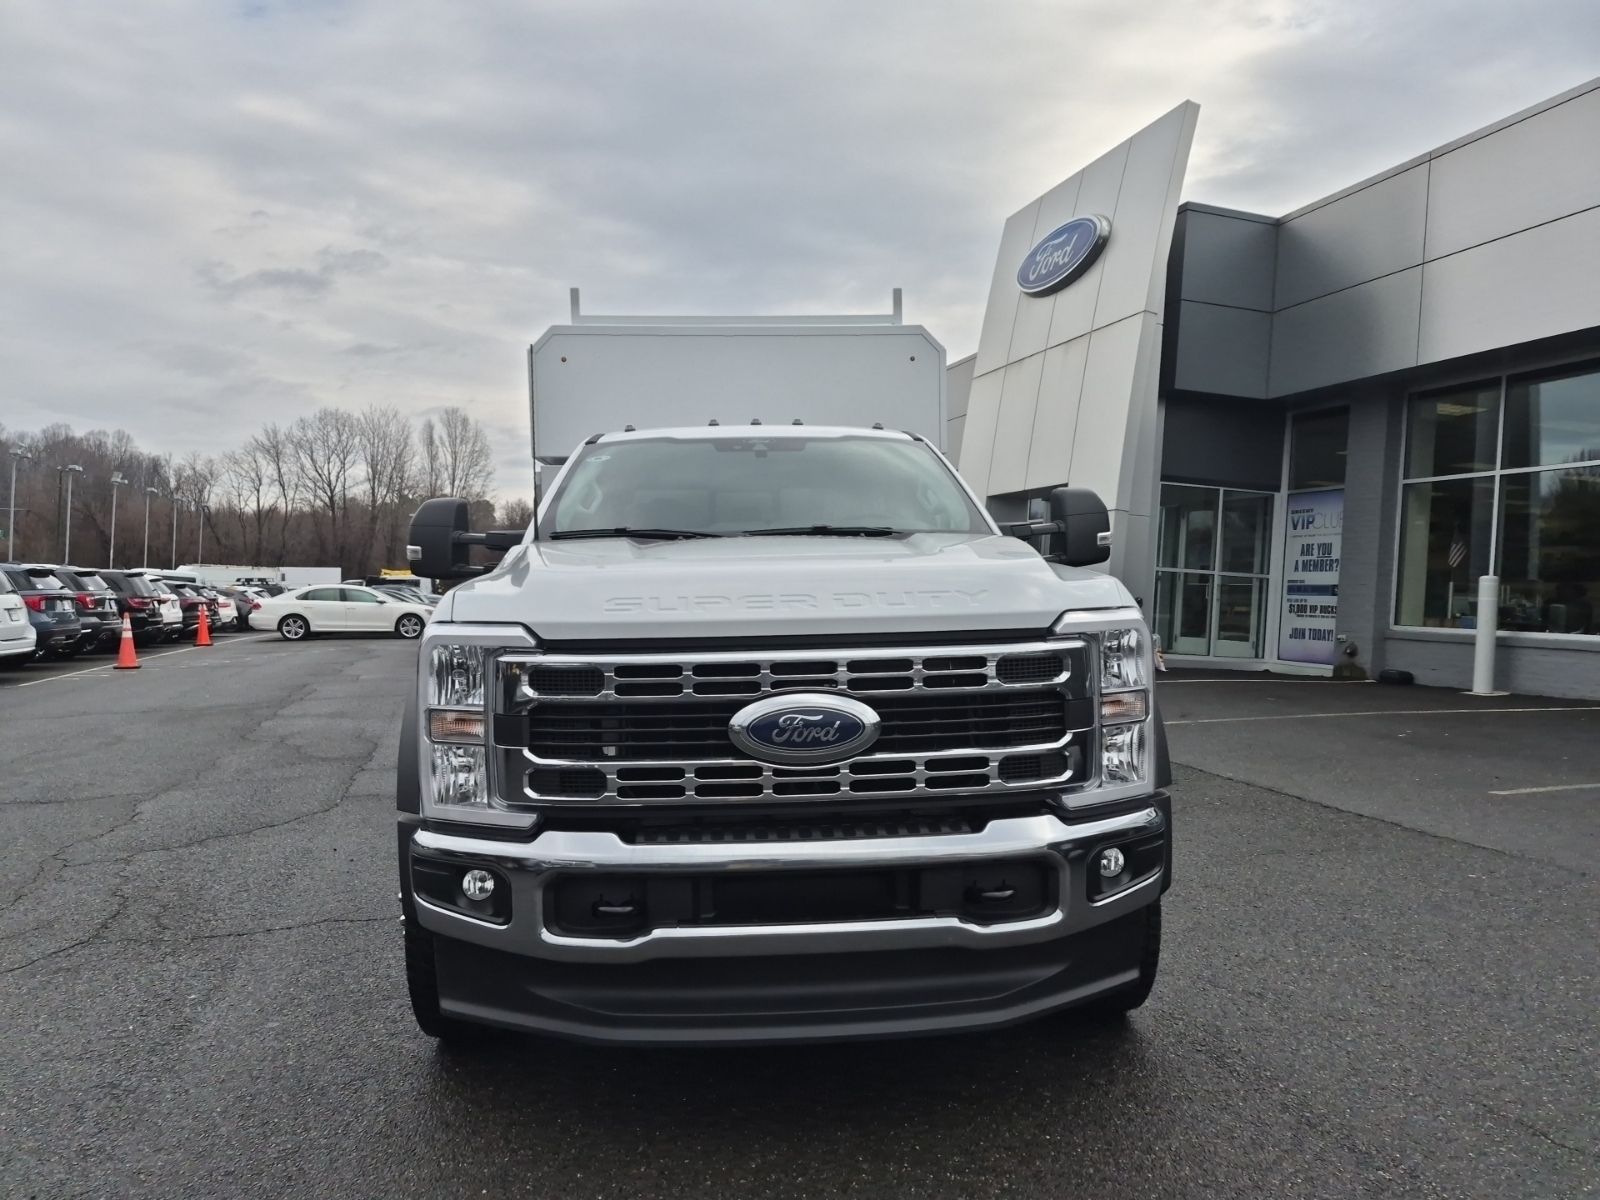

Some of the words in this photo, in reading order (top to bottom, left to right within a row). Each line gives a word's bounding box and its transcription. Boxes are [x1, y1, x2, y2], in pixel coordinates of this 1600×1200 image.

[1029, 233, 1078, 281] Ford
[1300, 544, 1315, 557] ARE
[1316, 543, 1332, 556] YOU
[1294, 560, 1299, 572] A
[1302, 558, 1339, 572] MEMBER?
[603, 593, 819, 615] SUPER
[832, 589, 990, 609] DUTY
[1289, 627, 1306, 640] JOIN
[1308, 628, 1333, 642] TODAY!
[771, 714, 840, 743] Ford
